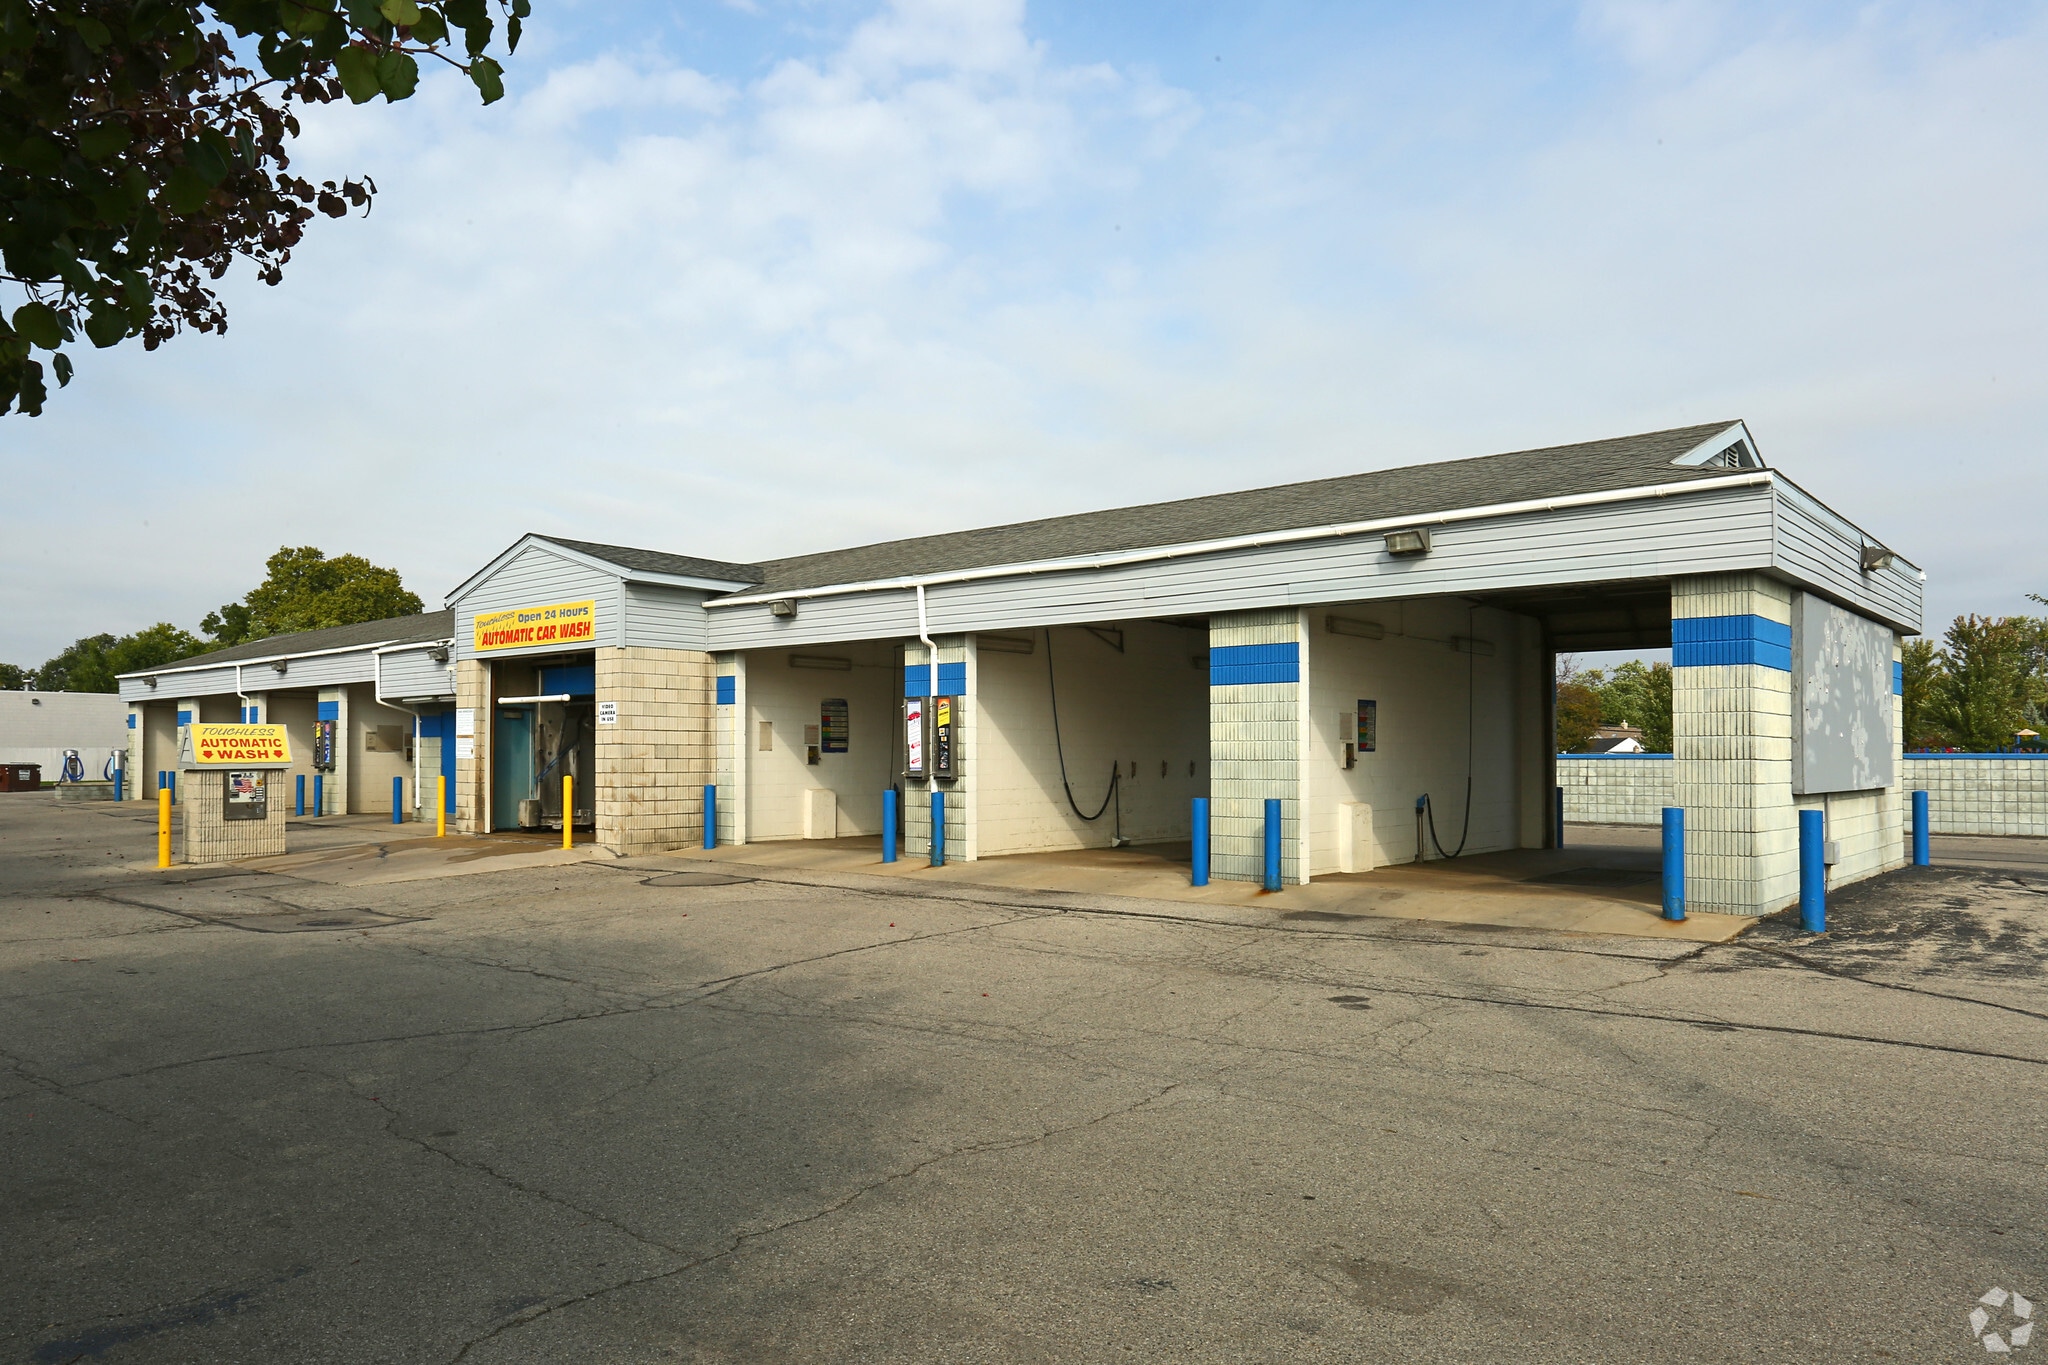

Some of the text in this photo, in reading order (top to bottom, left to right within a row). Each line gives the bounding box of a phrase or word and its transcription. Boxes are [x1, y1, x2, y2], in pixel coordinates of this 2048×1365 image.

[518, 607, 588, 623] Open 24 Hours
[482, 621, 591, 646] AUTOMATIC CAR WASH
[202, 727, 275, 736] TOUCHLESS
[201, 738, 282, 748] AUTOMATIC
[217, 749, 269, 759] WASH
